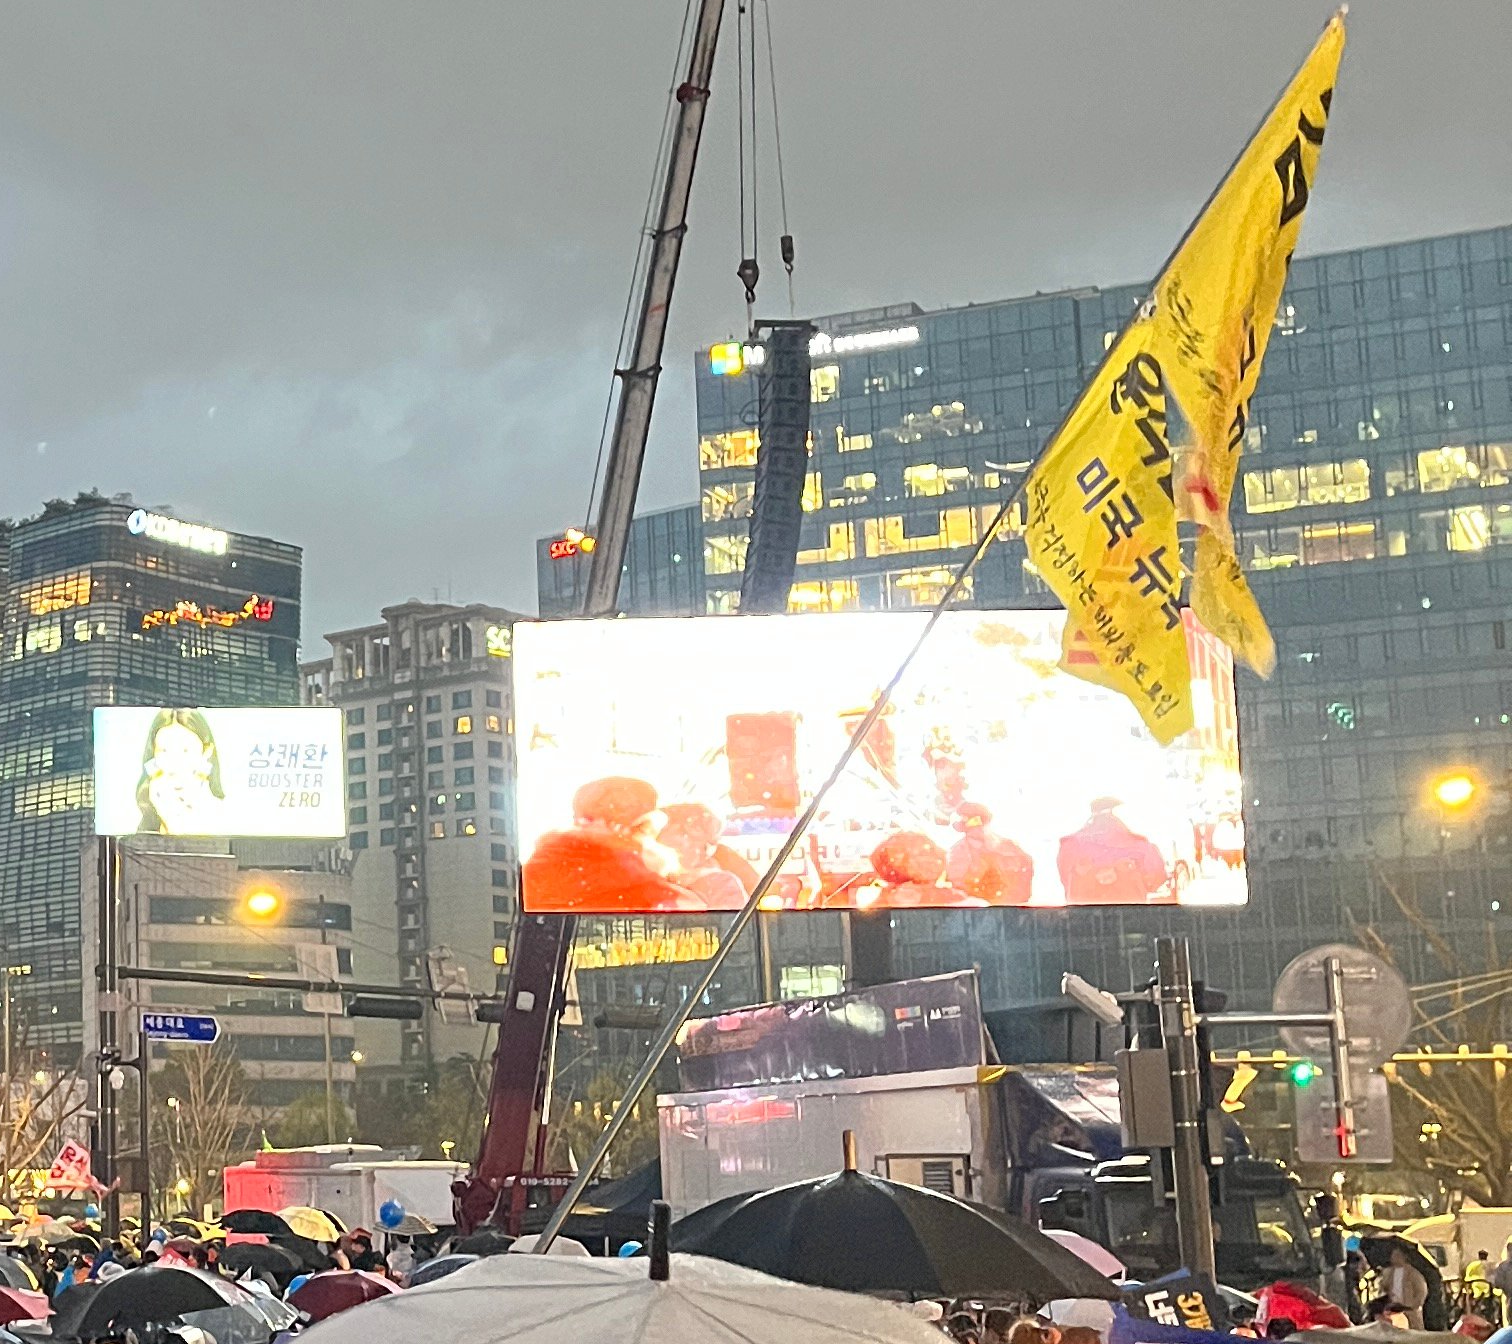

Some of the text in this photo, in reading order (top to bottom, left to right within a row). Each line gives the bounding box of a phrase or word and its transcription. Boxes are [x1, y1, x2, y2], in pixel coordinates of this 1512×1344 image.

[1076, 456, 1145, 550] 미국
[248, 773, 324, 788] BOOSTER
[278, 791, 321, 808] ZERO
